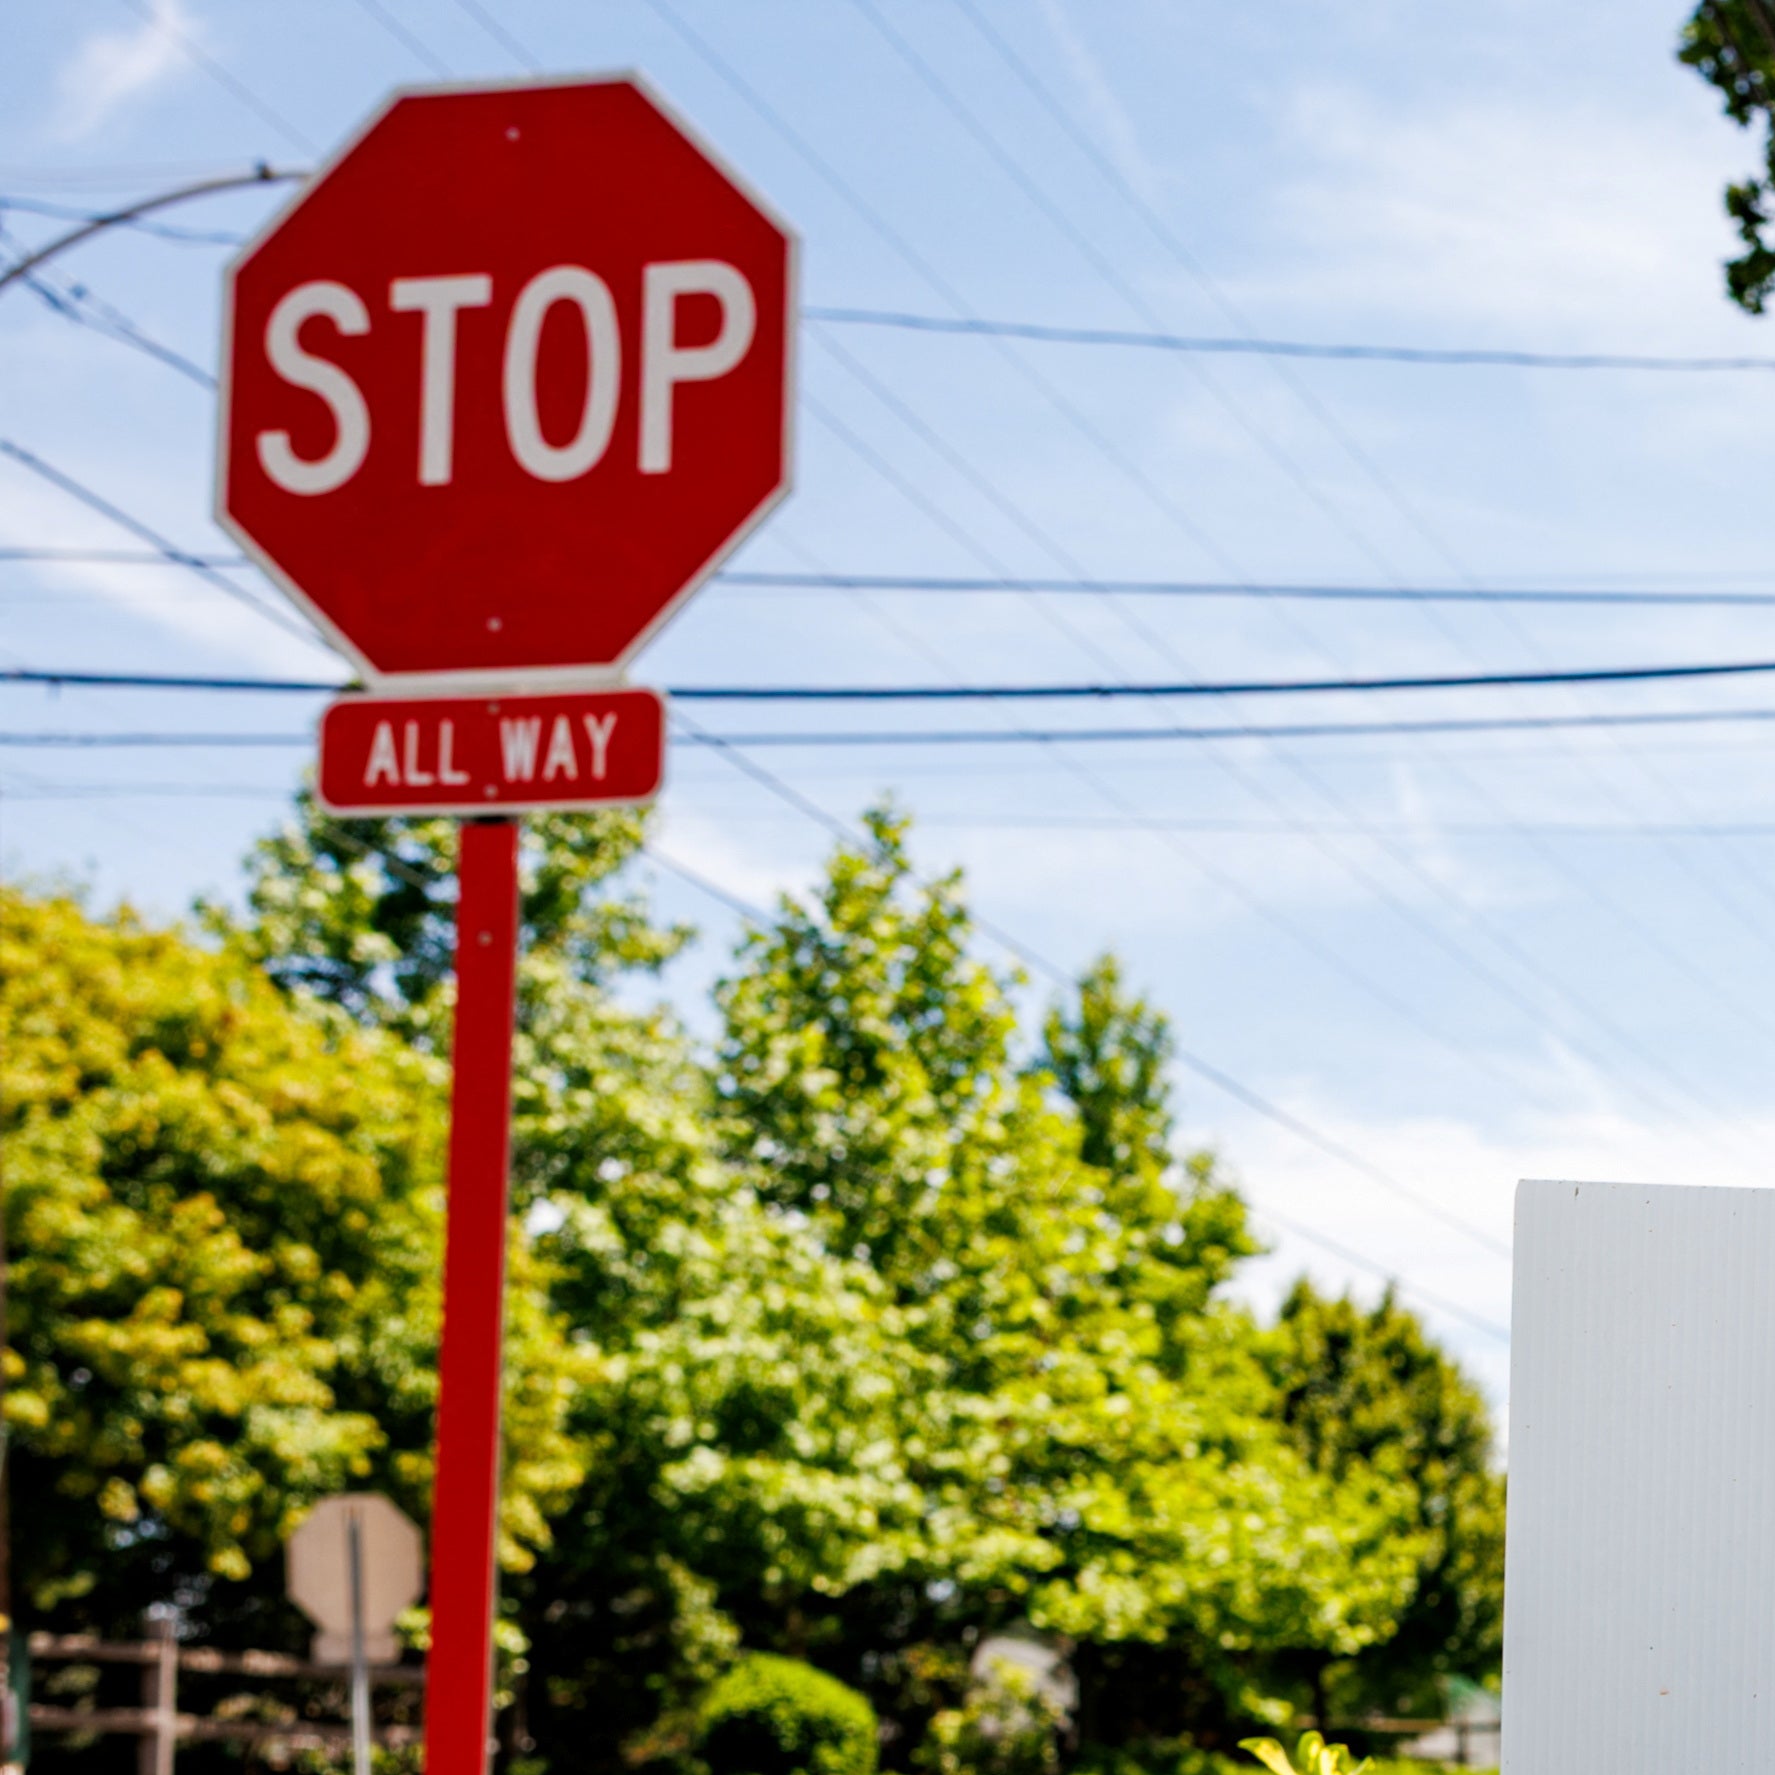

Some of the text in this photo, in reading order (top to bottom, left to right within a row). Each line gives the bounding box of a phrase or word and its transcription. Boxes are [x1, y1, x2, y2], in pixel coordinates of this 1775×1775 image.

[256, 258, 757, 496] STOP
[364, 712, 617, 787] ALL WAY
